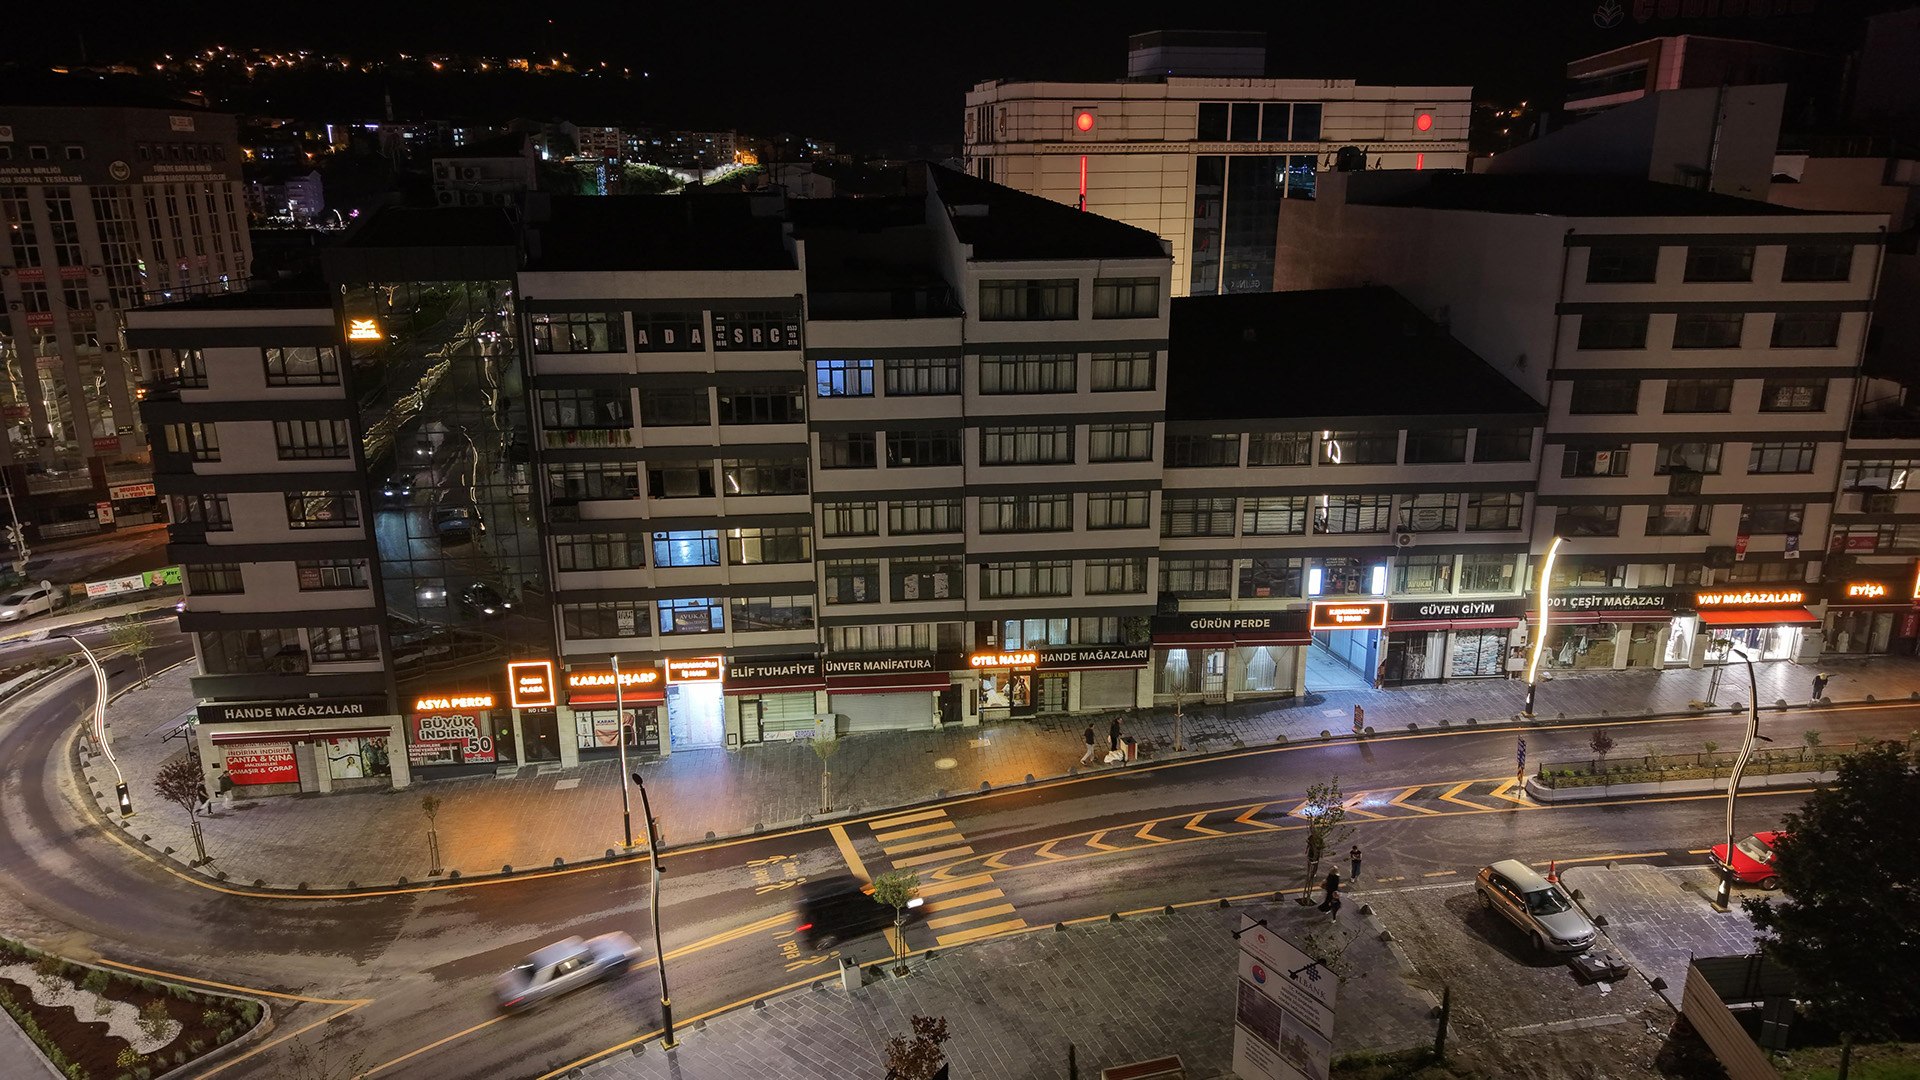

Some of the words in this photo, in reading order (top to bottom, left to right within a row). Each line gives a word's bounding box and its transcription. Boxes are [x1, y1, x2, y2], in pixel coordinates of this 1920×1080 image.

[0, 167, 31, 175] AROLAR
[13, 176, 43, 184] SOSYAL
[44, 174, 83, 184] TESİSLERİ
[27, 313, 53, 321] AVUKAT
[1547, 598, 1566, 607] 001
[1570, 595, 1602, 609] ÇEŞİT
[1604, 595, 1665, 606] MAĞAZASI
[1698, 596, 1722, 605] VAV
[1723, 593, 1802, 604] MAĞAZALARI
[1420, 604, 1459, 615] GÜVEN
[1462, 603, 1495, 614] GİYİM
[679, 612, 708, 620] AVUKAT
[1190, 618, 1231, 630] GÜRÜN
[1234, 618, 1271, 629] PERDE
[971, 656, 998, 667] OTEL
[999, 653, 1036, 665] NAZAR
[1040, 652, 1077, 663] HANDE
[1079, 648, 1148, 661] MAĞAZALARI
[731, 665, 755, 678] ELİF
[757, 663, 815, 677] TUHAFİYE
[825, 660, 861, 672] ÜNVER
[863, 658, 932, 671] MANİFATURA
[570, 674, 615, 687] KARAN
[416, 699, 450, 710] ASYA
[451, 697, 493, 708] PERDE
[224, 707, 273, 719] HANDE
[275, 703, 363, 718] MAĞAZALARI
[420, 715, 475, 730] BÜYÜK
[419, 727, 478, 741] İNDİRİM
[227, 756, 258, 764] ÇANTA
[268, 754, 294, 762] KINA
[228, 768, 259, 776] ÇAMAŞIR
[268, 765, 294, 773] ÇORAP
[777, 939, 801, 960] yaya
